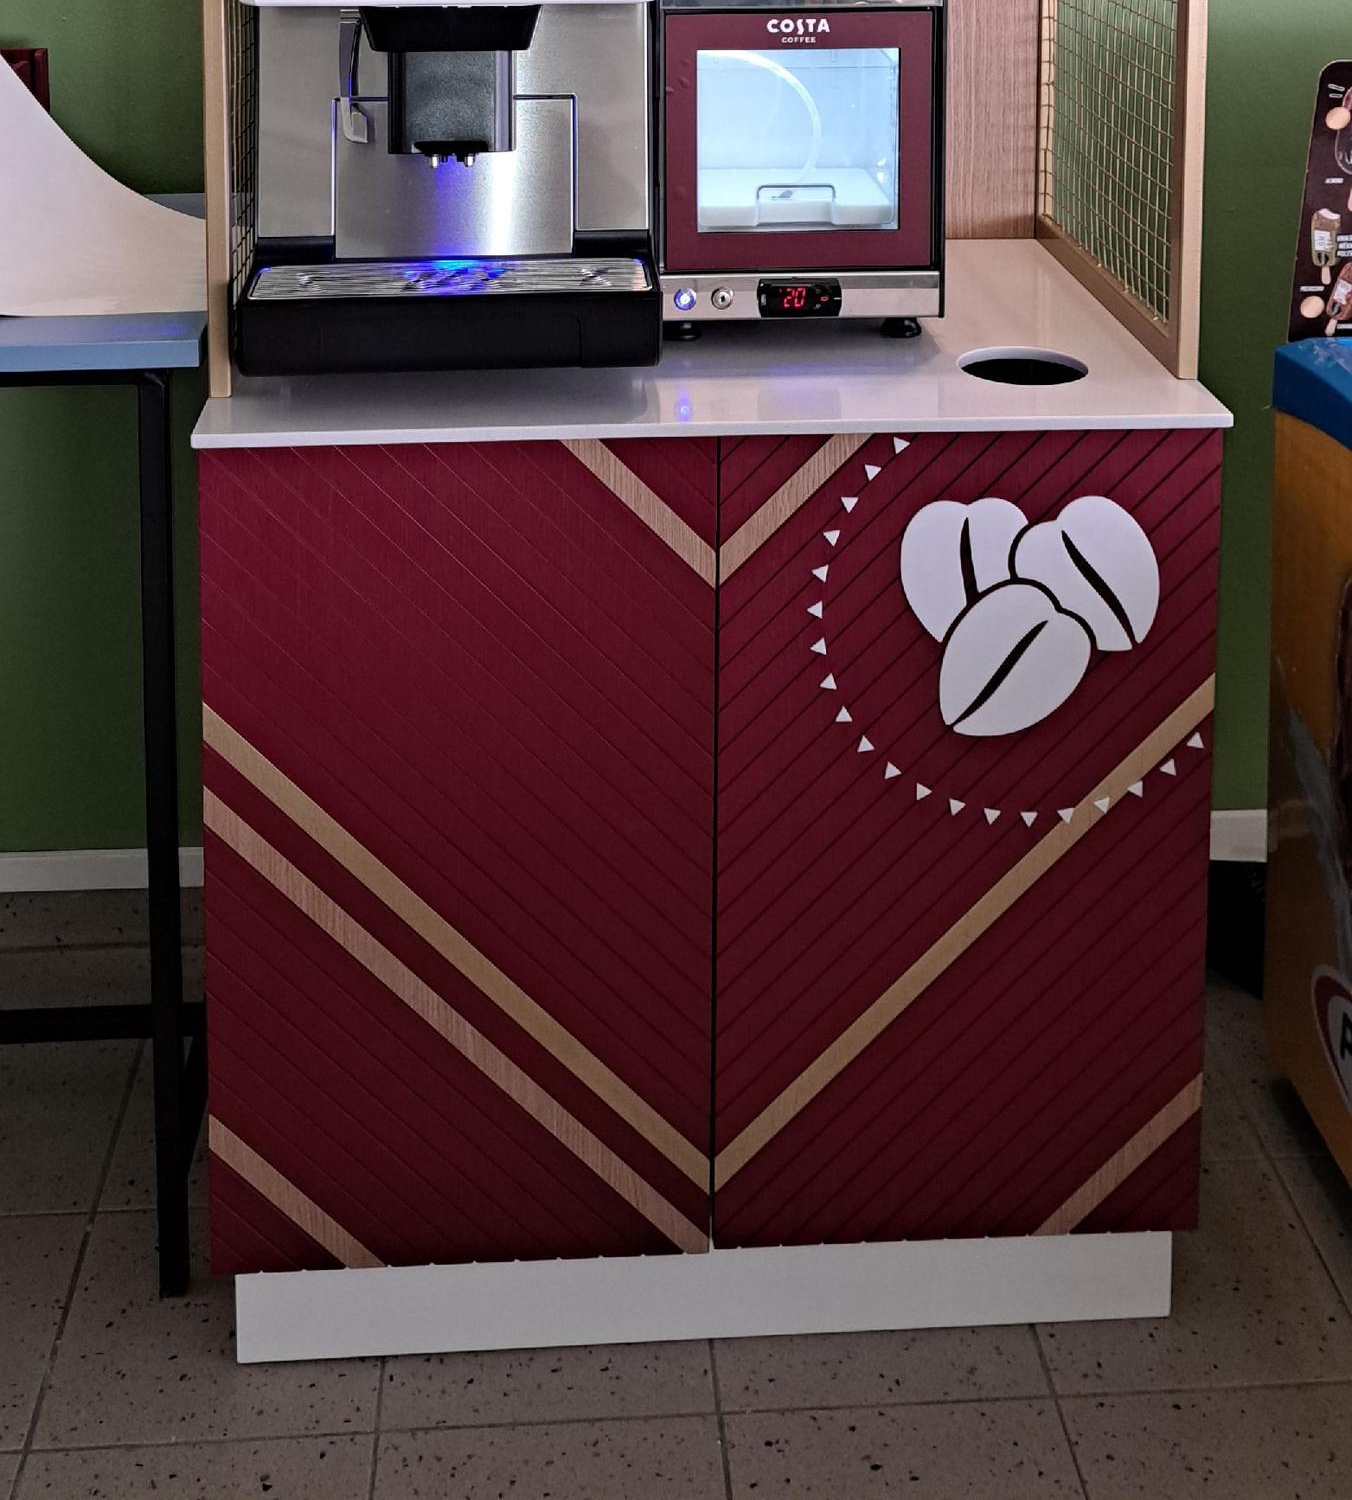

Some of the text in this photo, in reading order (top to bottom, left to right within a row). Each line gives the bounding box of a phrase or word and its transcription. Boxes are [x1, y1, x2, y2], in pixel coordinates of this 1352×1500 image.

[766, 18, 831, 36] COSTA
[781, 36, 817, 44] COFFEE
[783, 287, 807, 309] 20
